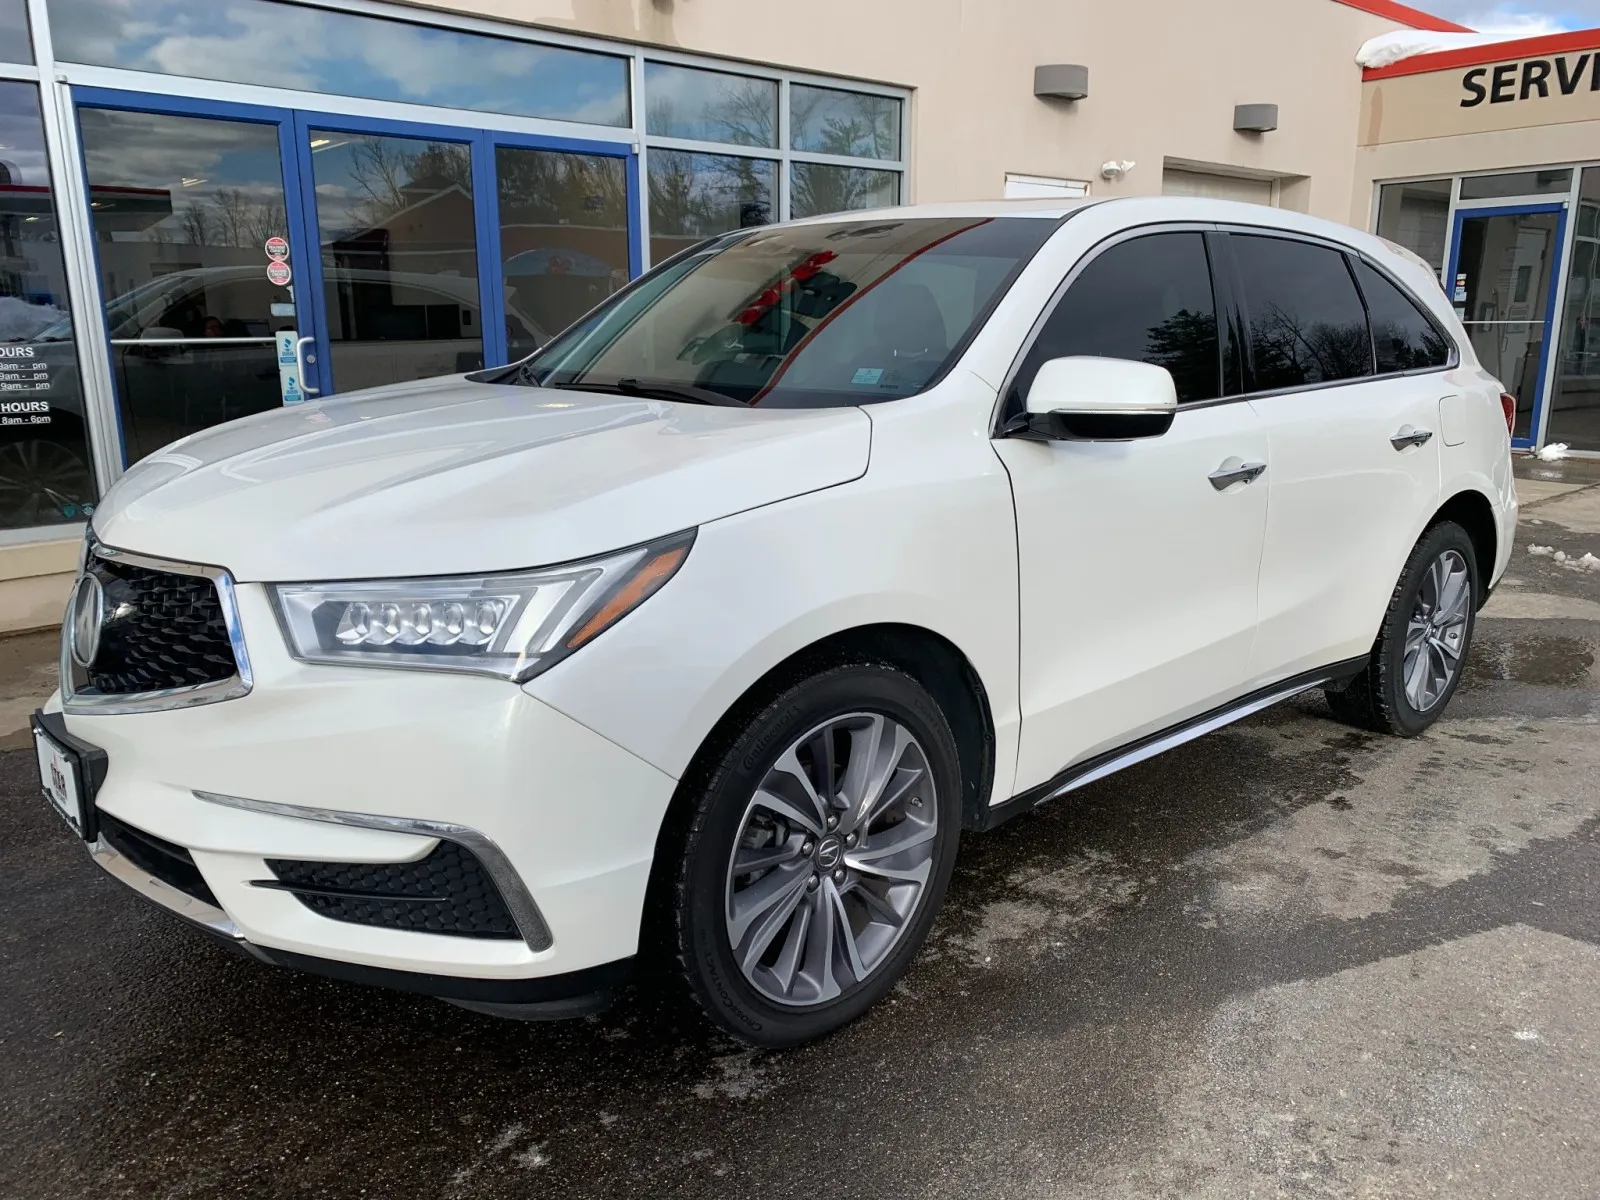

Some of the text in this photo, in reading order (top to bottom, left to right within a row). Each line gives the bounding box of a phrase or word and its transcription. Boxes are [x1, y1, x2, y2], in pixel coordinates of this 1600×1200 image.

[0, 382, 22, 390] 9am
[0, 401, 49, 412] HOURS
[1, 416, 23, 425] 8am
[30, 415, 51, 424] 6pm
